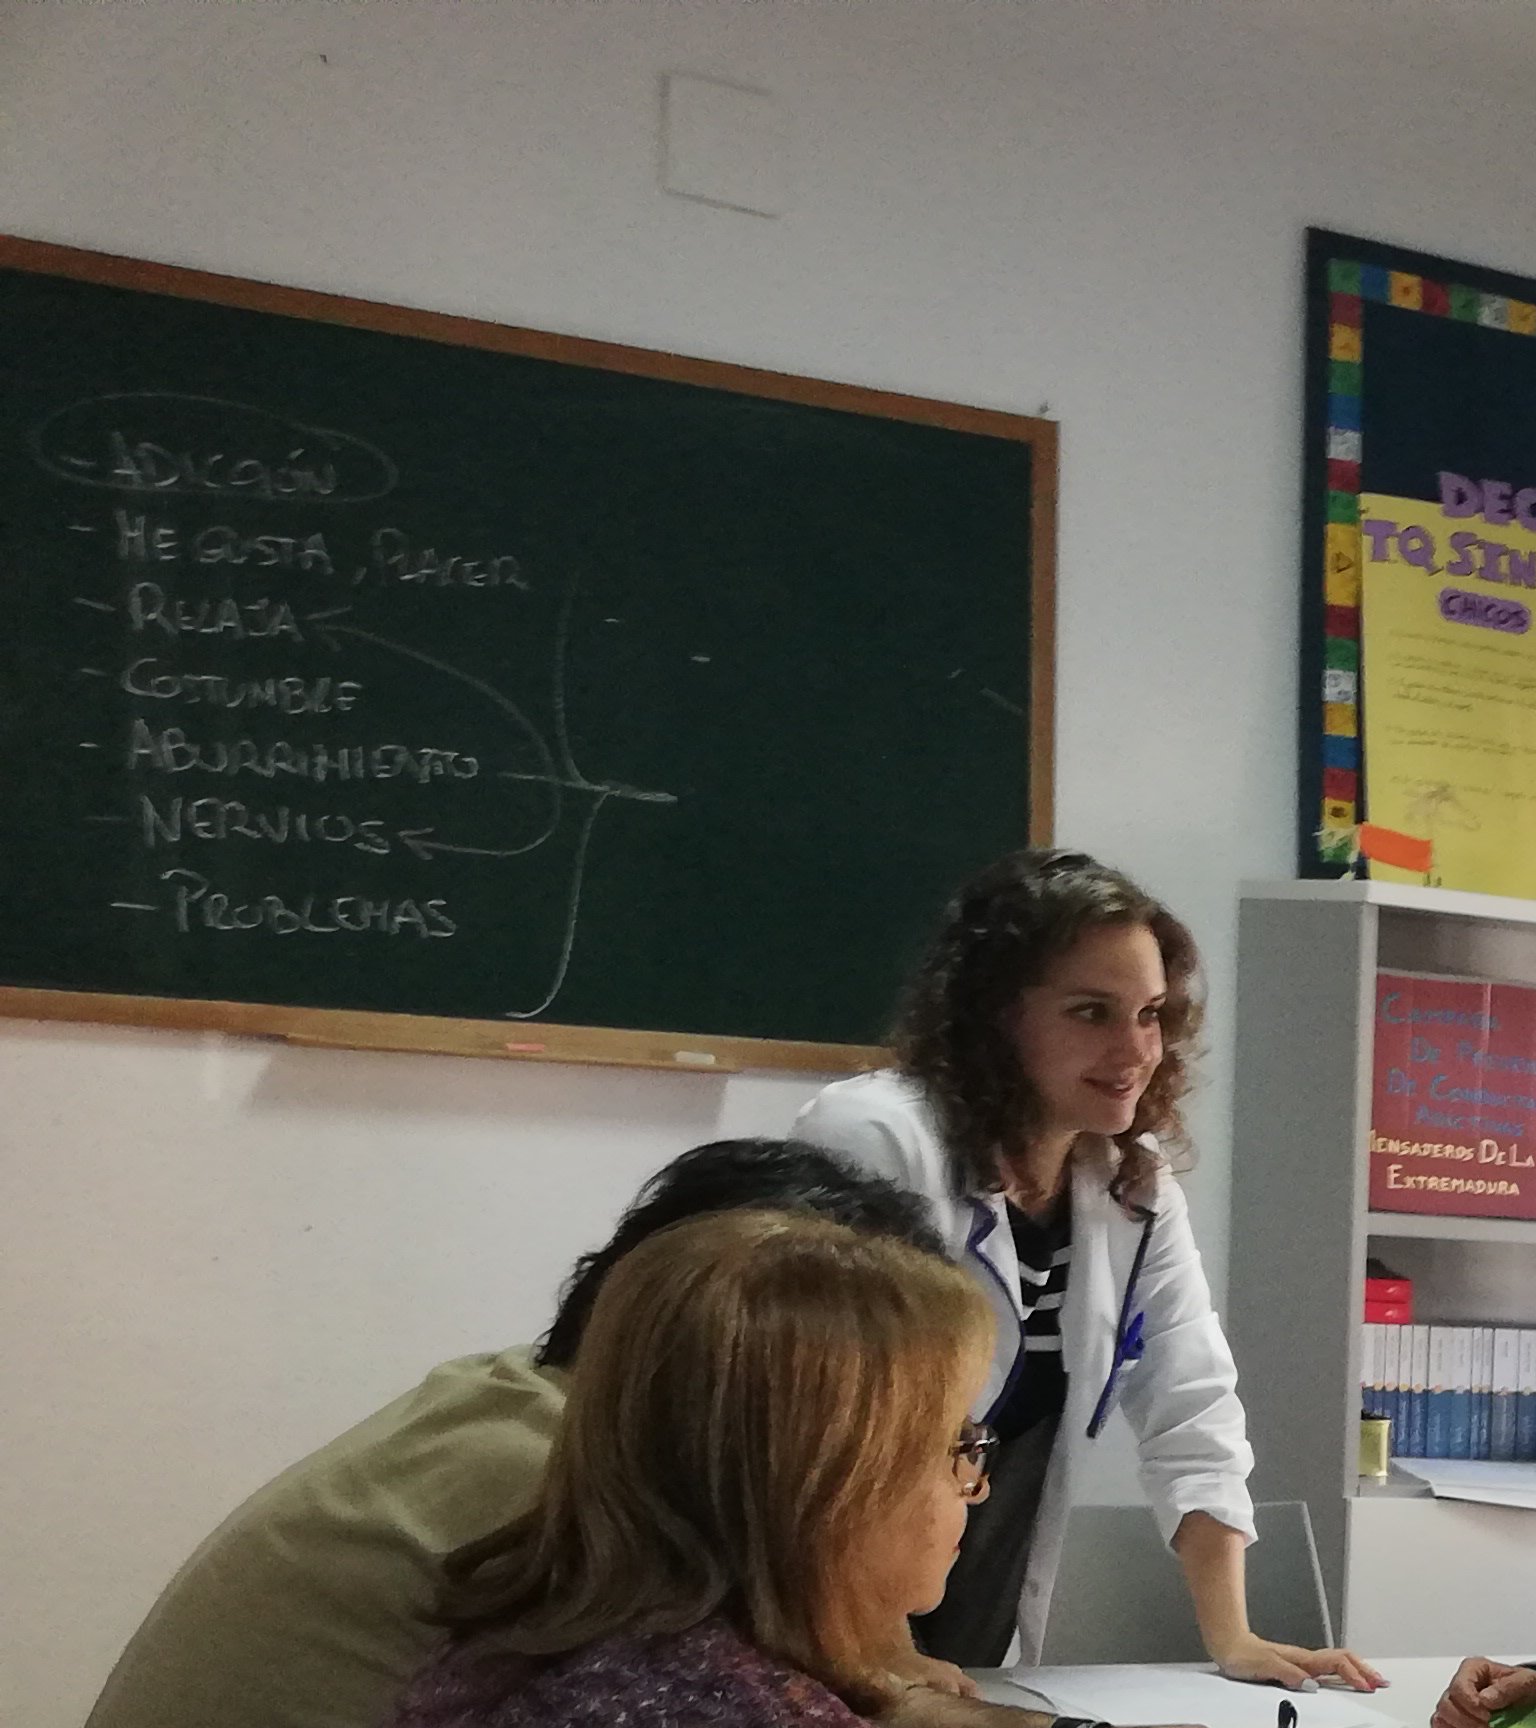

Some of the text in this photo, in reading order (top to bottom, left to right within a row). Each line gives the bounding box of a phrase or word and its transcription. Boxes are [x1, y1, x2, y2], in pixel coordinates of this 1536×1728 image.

[139, 796, 392, 856] NERVIOS
[160, 868, 458, 938] PROBLEMAS
[1386, 1164, 1520, 1195] EXTREMADURA
